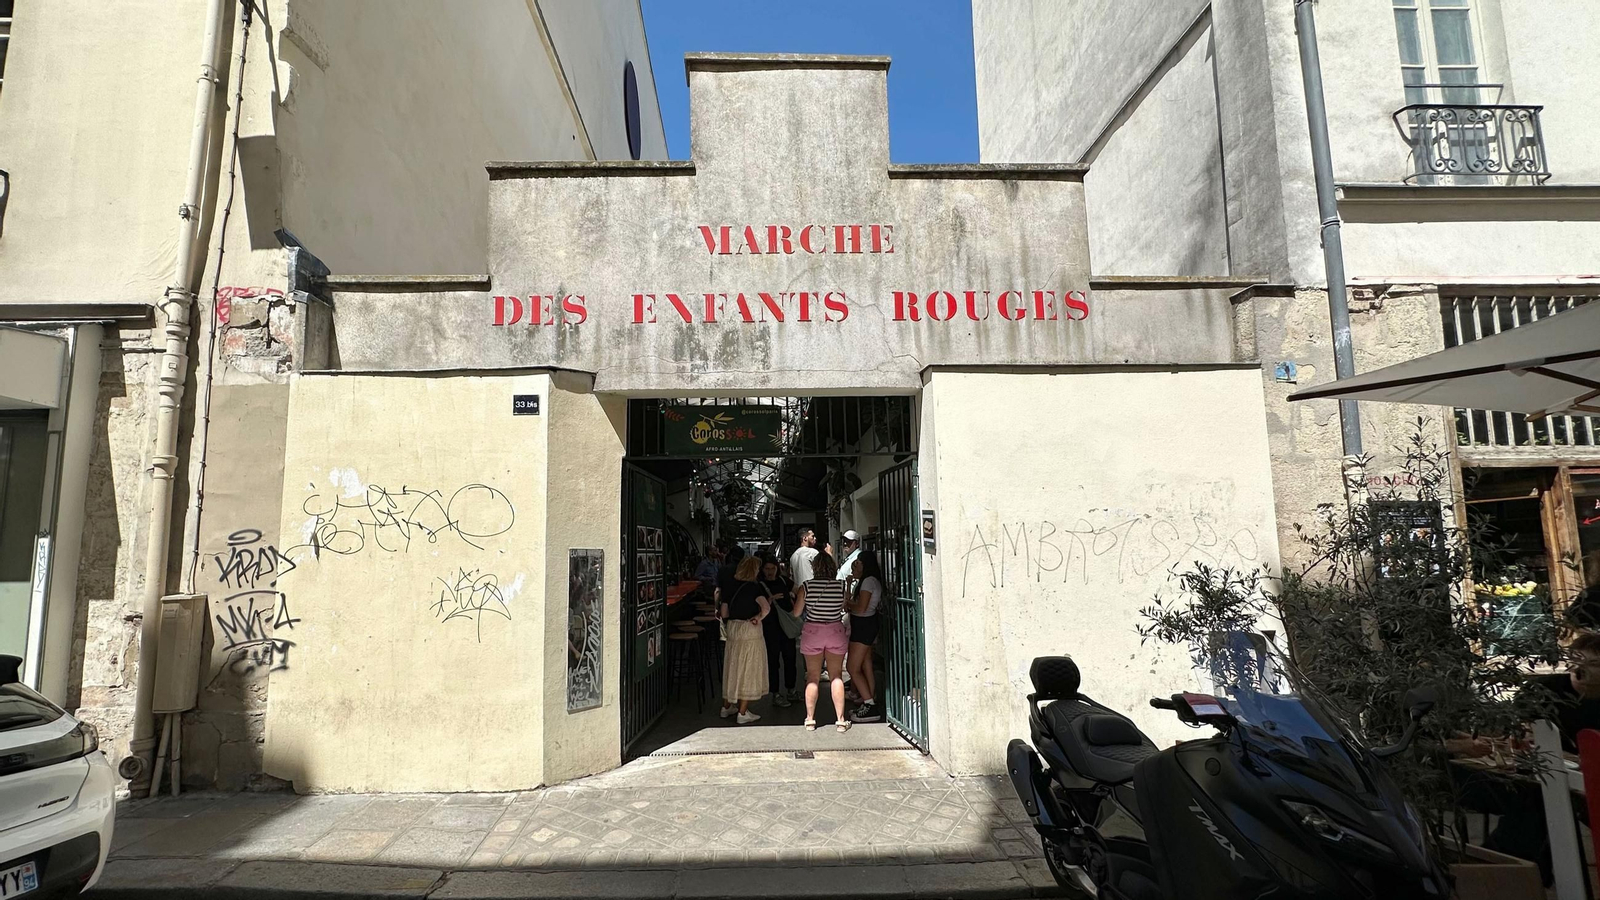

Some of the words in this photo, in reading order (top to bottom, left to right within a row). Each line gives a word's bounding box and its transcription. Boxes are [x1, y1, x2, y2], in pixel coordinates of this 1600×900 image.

[697, 225, 895, 256] MARCHE
[492, 294, 588, 326] DES
[631, 291, 849, 324] ENFANTS
[892, 290, 1091, 322] ROUGES
[515, 400, 525, 408] 33
[527, 400, 538, 408] bis
[1188, 797, 1245, 861] TMAX
